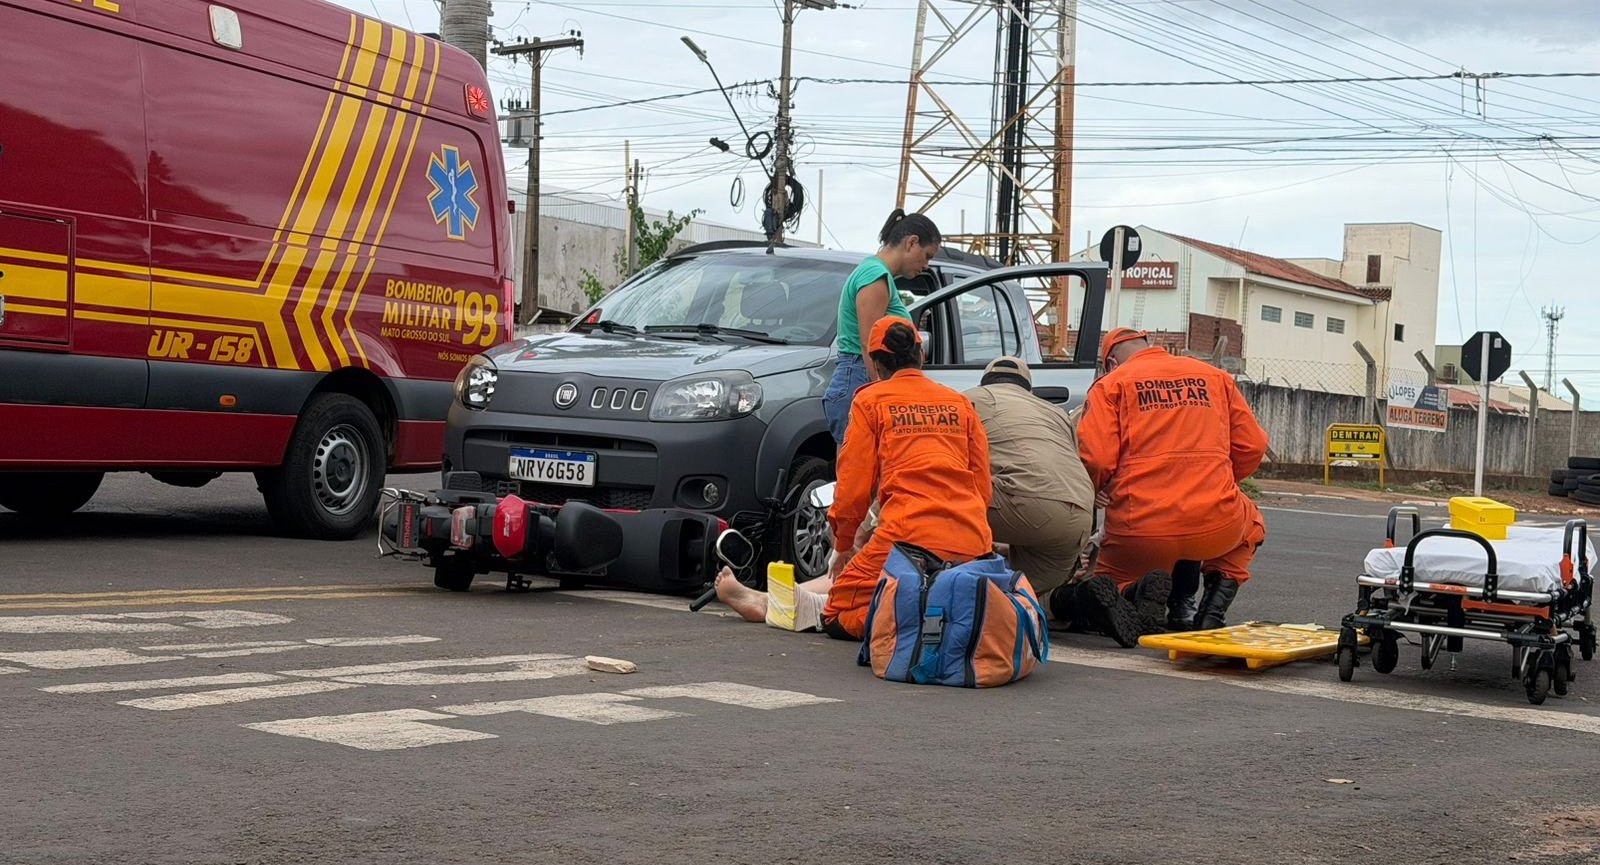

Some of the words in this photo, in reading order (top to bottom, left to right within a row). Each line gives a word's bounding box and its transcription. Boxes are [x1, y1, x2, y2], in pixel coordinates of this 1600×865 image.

[385, 279, 453, 305] BOMBEIRO
[382, 301, 452, 330] MILITAR
[454, 290, 499, 347] 193
[381, 327, 400, 338] MATO
[401, 329, 427, 340] GROSSO
[428, 331, 438, 341] DO
[439, 333, 451, 343] SUL
[1135, 378, 1206, 390] BOMBEIRO
[1395, 386, 1415, 398] LOPES
[1138, 388, 1210, 406] MILITAR
[888, 405, 958, 414] BOMBEIRO
[1139, 402, 1159, 412] MATO
[891, 413, 960, 426] MILITAR
[1390, 407, 1413, 422] ALUGA
[1415, 411, 1445, 426] TERRENO
[1332, 430, 1379, 440] DEMTRAN
[517, 459, 585, 481] NRY6G58
